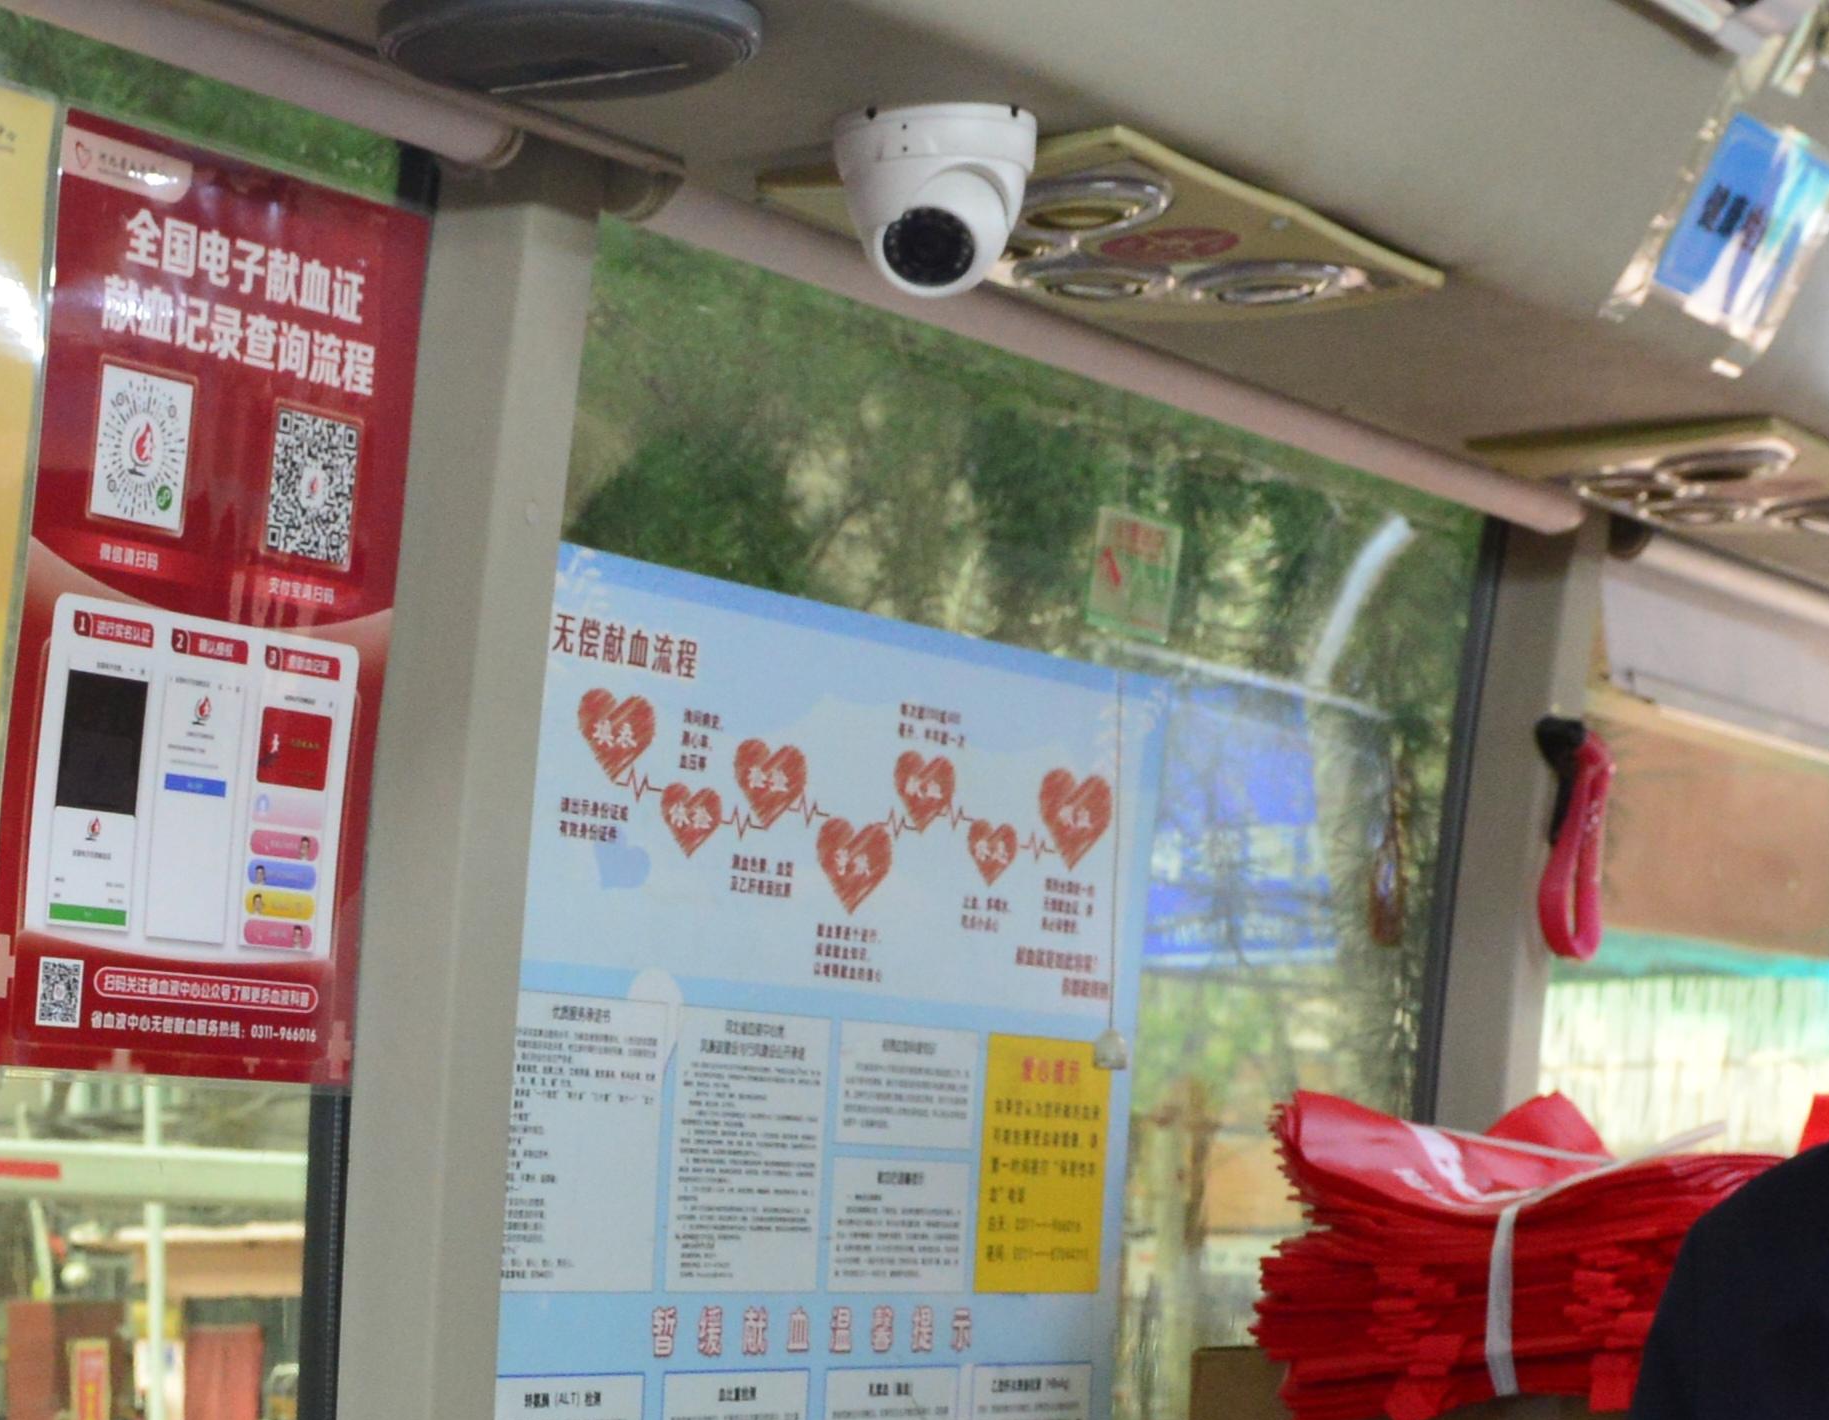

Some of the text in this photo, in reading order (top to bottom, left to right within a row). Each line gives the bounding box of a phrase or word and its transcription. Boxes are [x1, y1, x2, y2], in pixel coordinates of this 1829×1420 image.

[125, 208, 366, 326] 全国电子献血证
[101, 274, 376, 398] 献血记录查询流程
[77, 616, 86, 632] 1
[174, 632, 184, 649] 2
[551, 611, 698, 682] 无偿献血流程
[268, 650, 277, 665] 3
[592, 719, 638, 749] 填表
[1020, 1055, 1082, 1086] 爱心提示
[649, 1306, 973, 1360] 暂缓献血温馨提示
